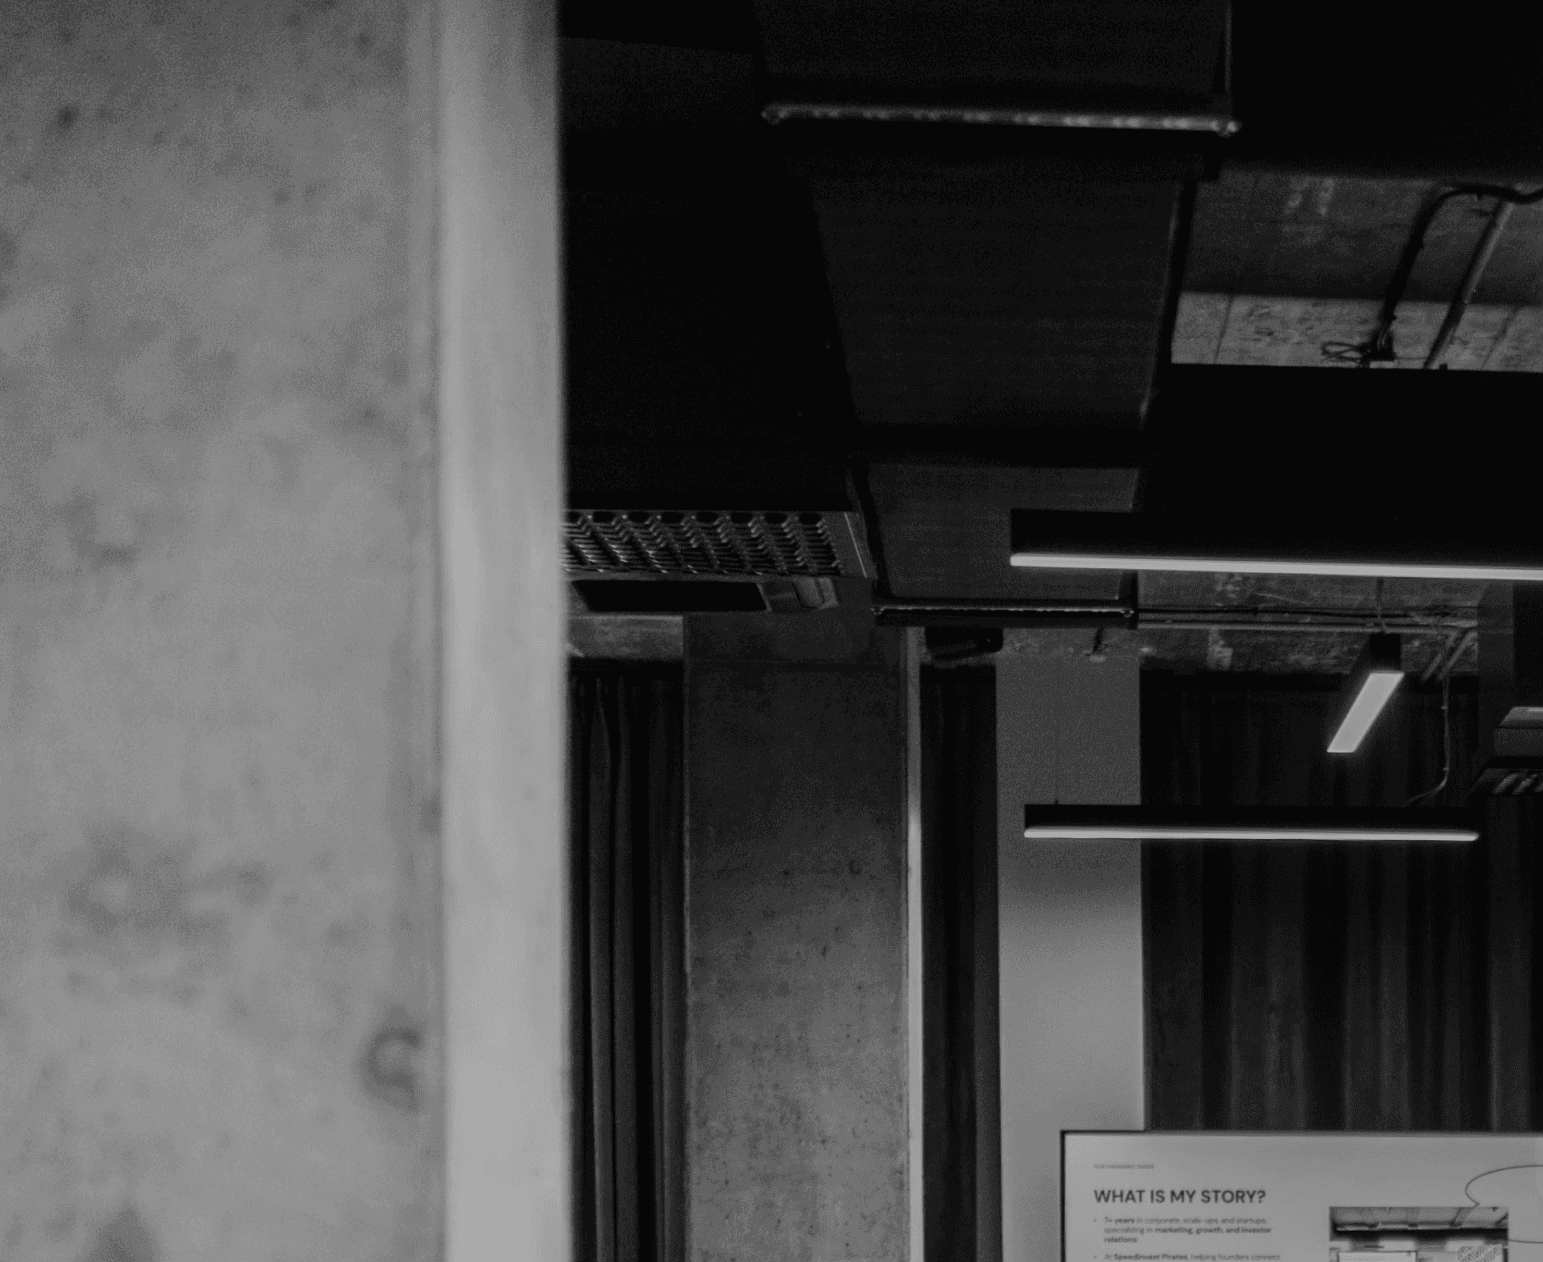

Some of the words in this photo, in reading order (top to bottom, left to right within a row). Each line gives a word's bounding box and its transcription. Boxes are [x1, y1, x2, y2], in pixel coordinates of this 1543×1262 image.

[1094, 1189, 1146, 1204] WHAT
[1150, 1189, 1165, 1204] IS
[1170, 1189, 1196, 1204] MY
[1201, 1189, 1266, 1204] STORY?
